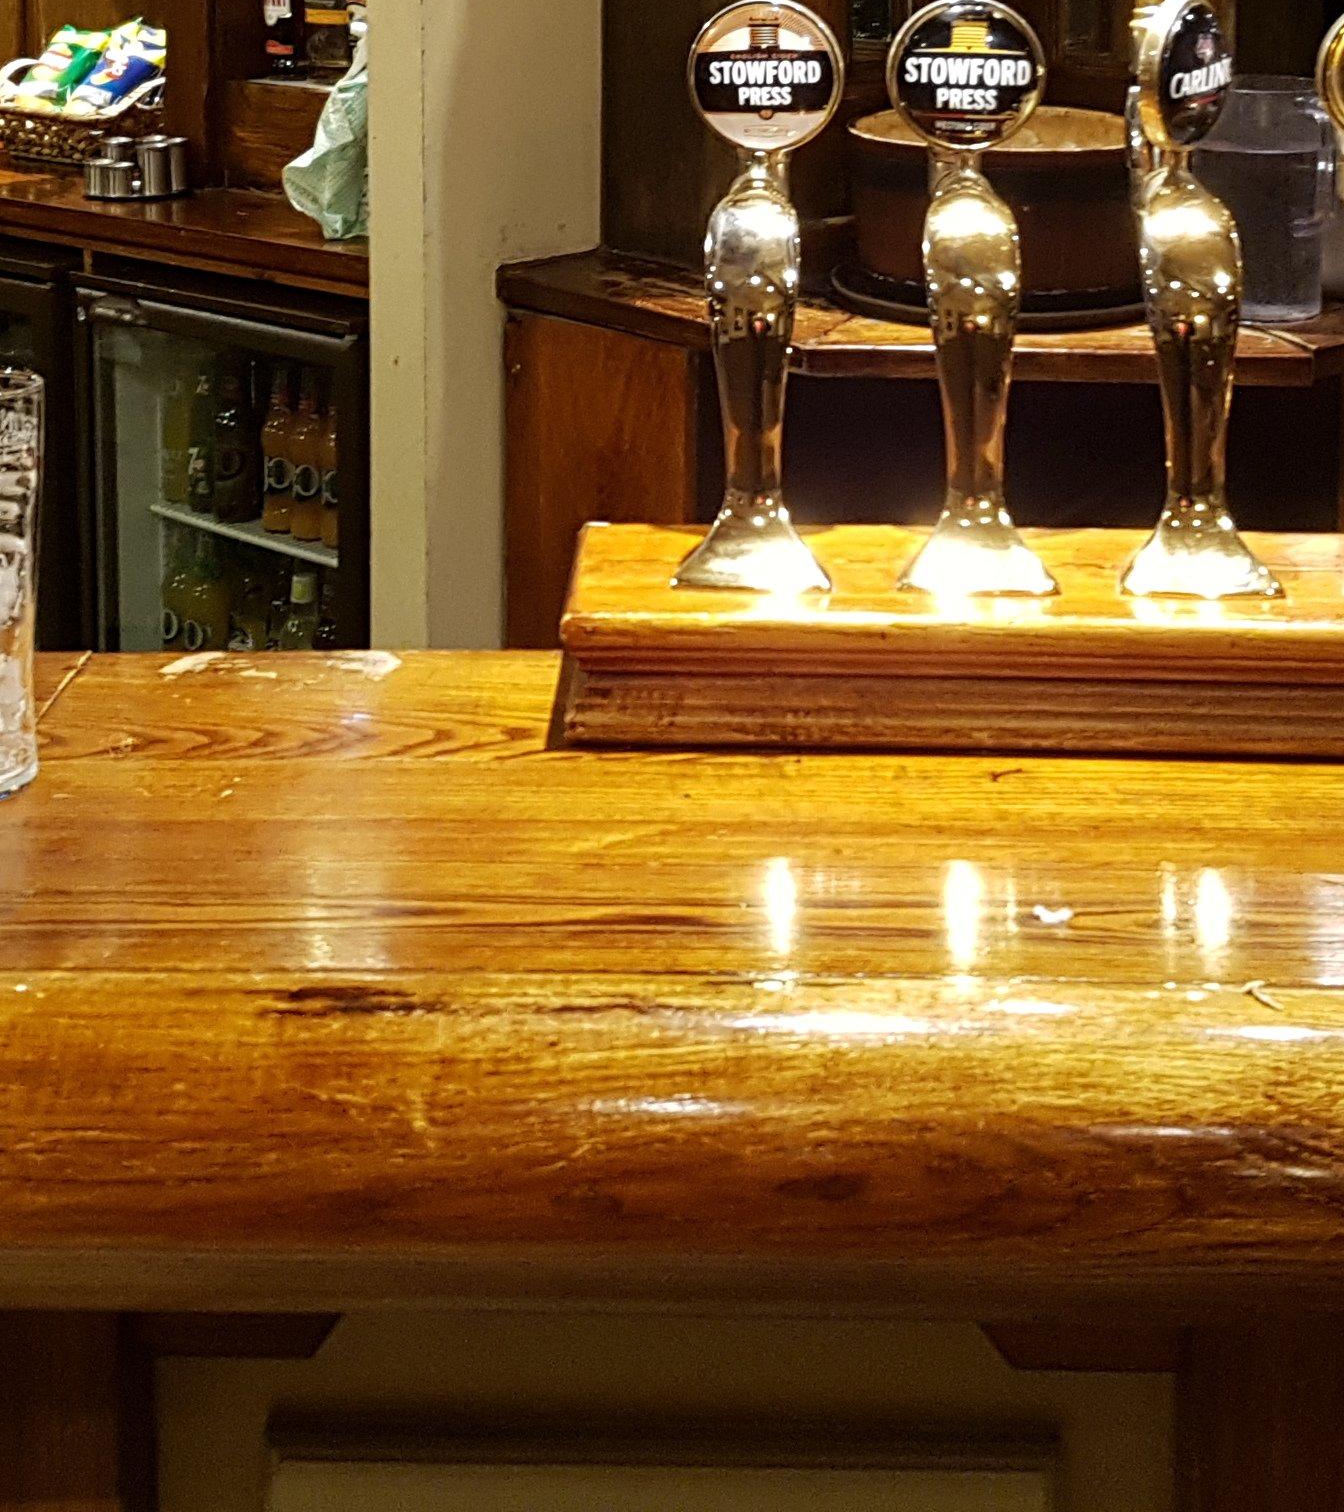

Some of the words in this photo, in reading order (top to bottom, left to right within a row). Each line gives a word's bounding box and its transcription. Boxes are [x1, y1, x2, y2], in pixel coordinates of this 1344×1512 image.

[708, 60, 822, 86] STOWFORD
[904, 56, 1032, 87] STOWFORD
[737, 86, 792, 106] PRESS
[935, 87, 998, 110] PRESS
